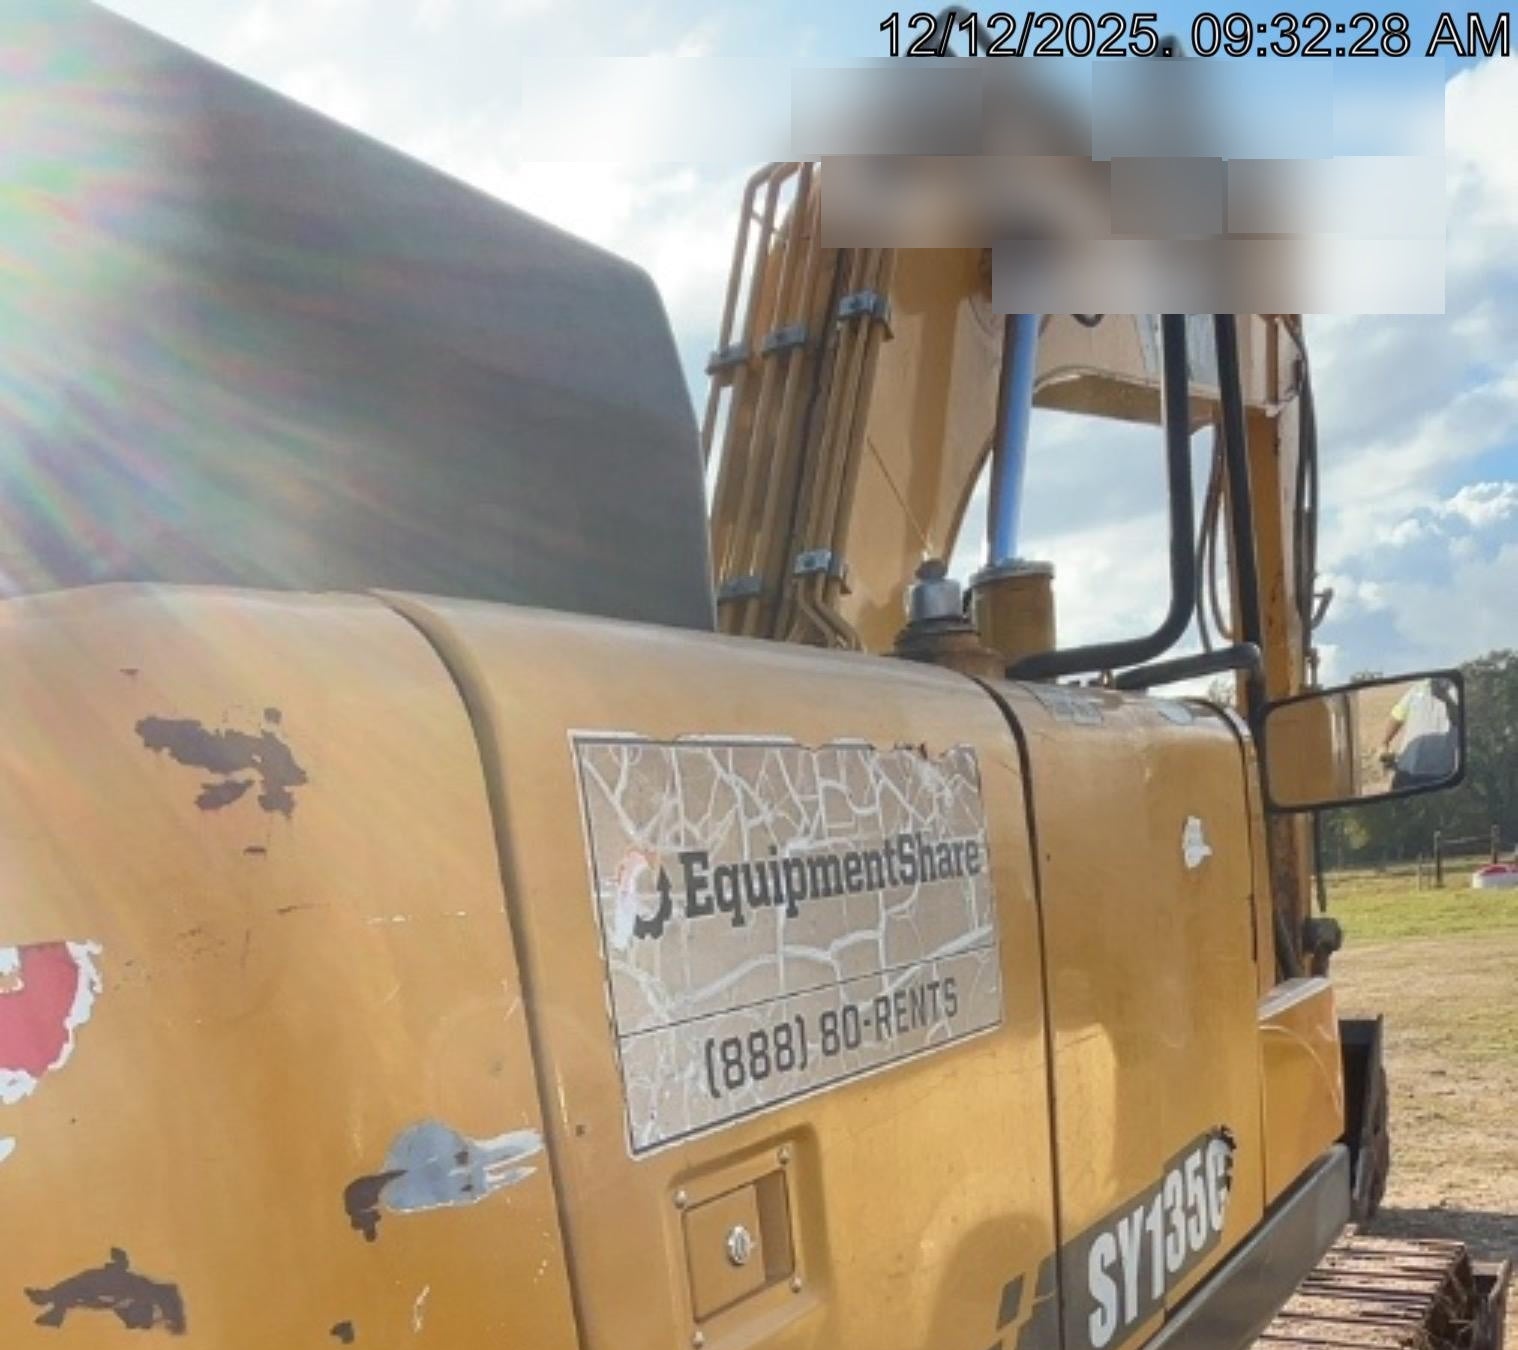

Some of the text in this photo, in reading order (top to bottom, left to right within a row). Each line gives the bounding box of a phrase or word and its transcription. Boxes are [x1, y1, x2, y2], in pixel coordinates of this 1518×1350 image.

[678, 831, 982, 927] EquipmentShare
[704, 976, 959, 1098] (888) 80-RENTS
[1087, 1137, 1232, 1349] SY135C
